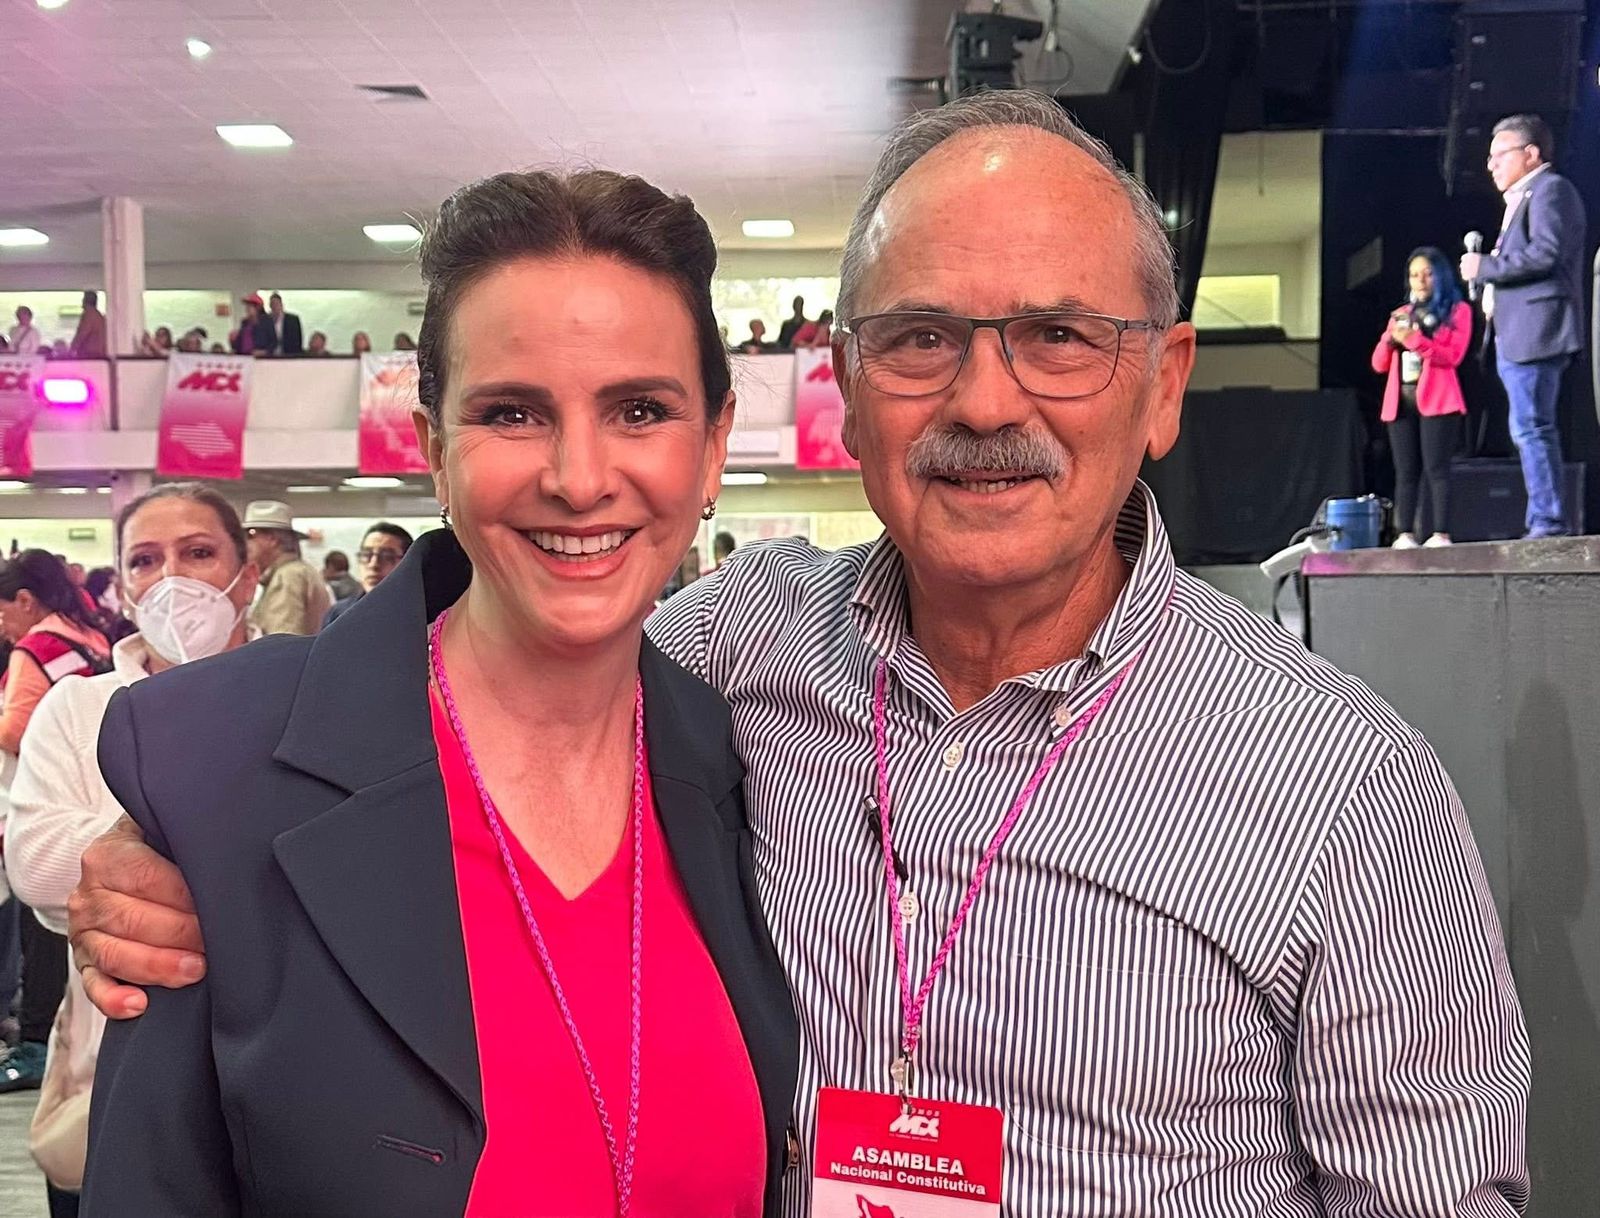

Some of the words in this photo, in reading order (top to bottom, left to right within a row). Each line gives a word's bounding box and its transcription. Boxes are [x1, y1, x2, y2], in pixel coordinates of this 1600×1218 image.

[852, 1146, 964, 1176] ASAMBLEA
[830, 1162, 893, 1182] Nacional
[896, 1171, 986, 1196] Constitutiva
